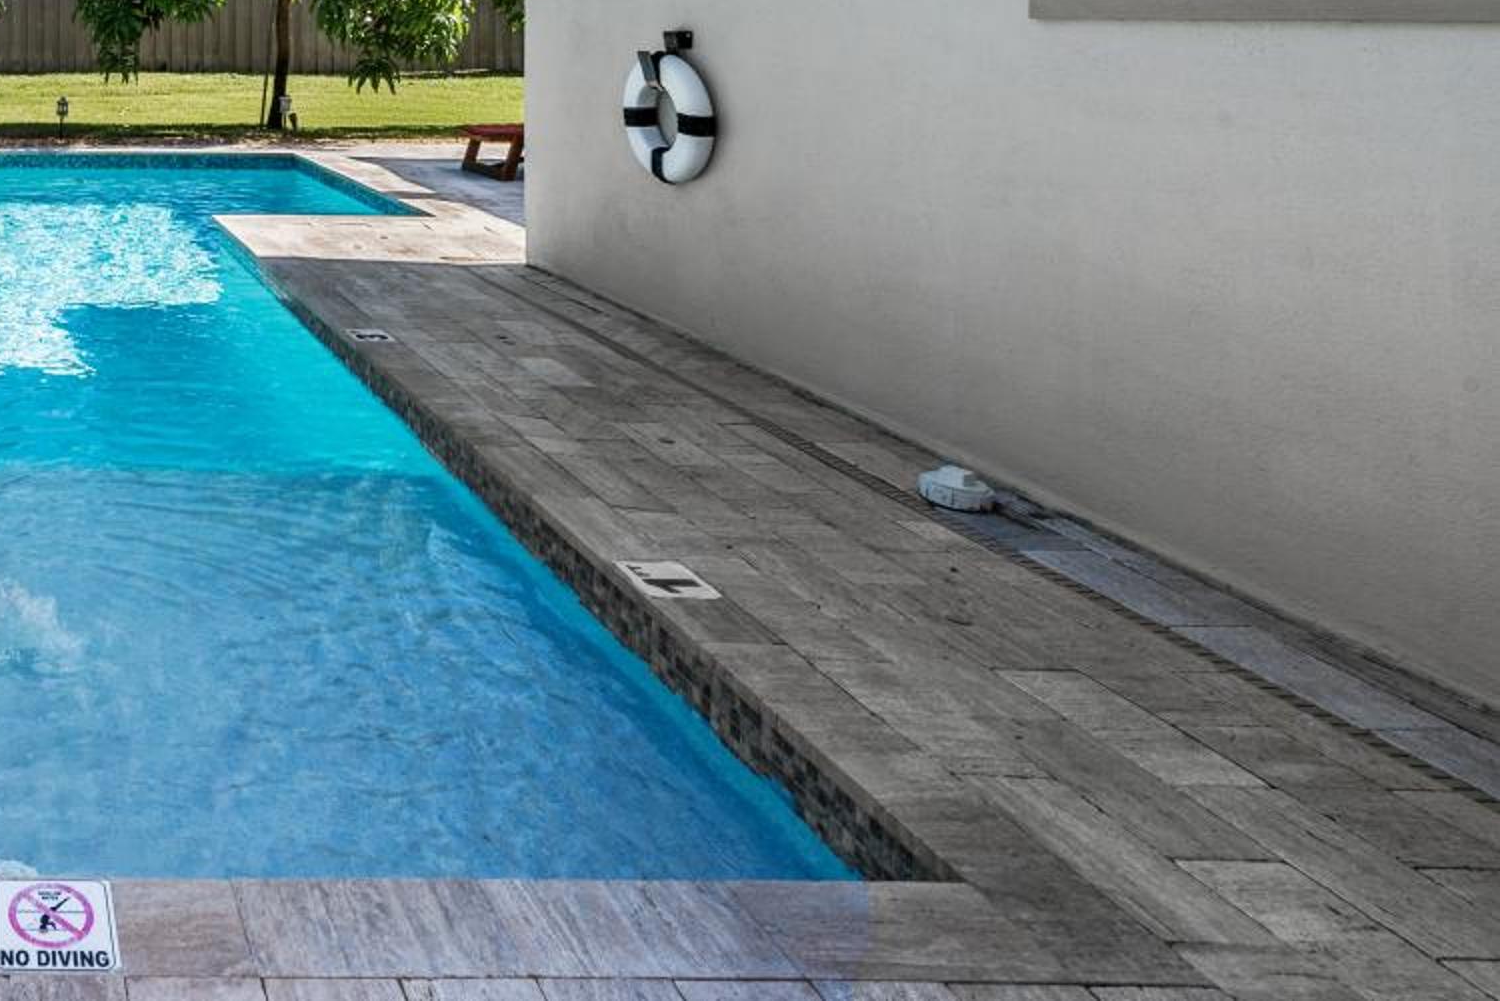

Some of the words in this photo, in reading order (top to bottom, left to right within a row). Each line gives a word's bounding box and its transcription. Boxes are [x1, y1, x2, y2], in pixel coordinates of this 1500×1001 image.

[642, 578, 702, 593] 1
[0, 950, 30, 967] NO
[37, 950, 110, 968] DIVING
